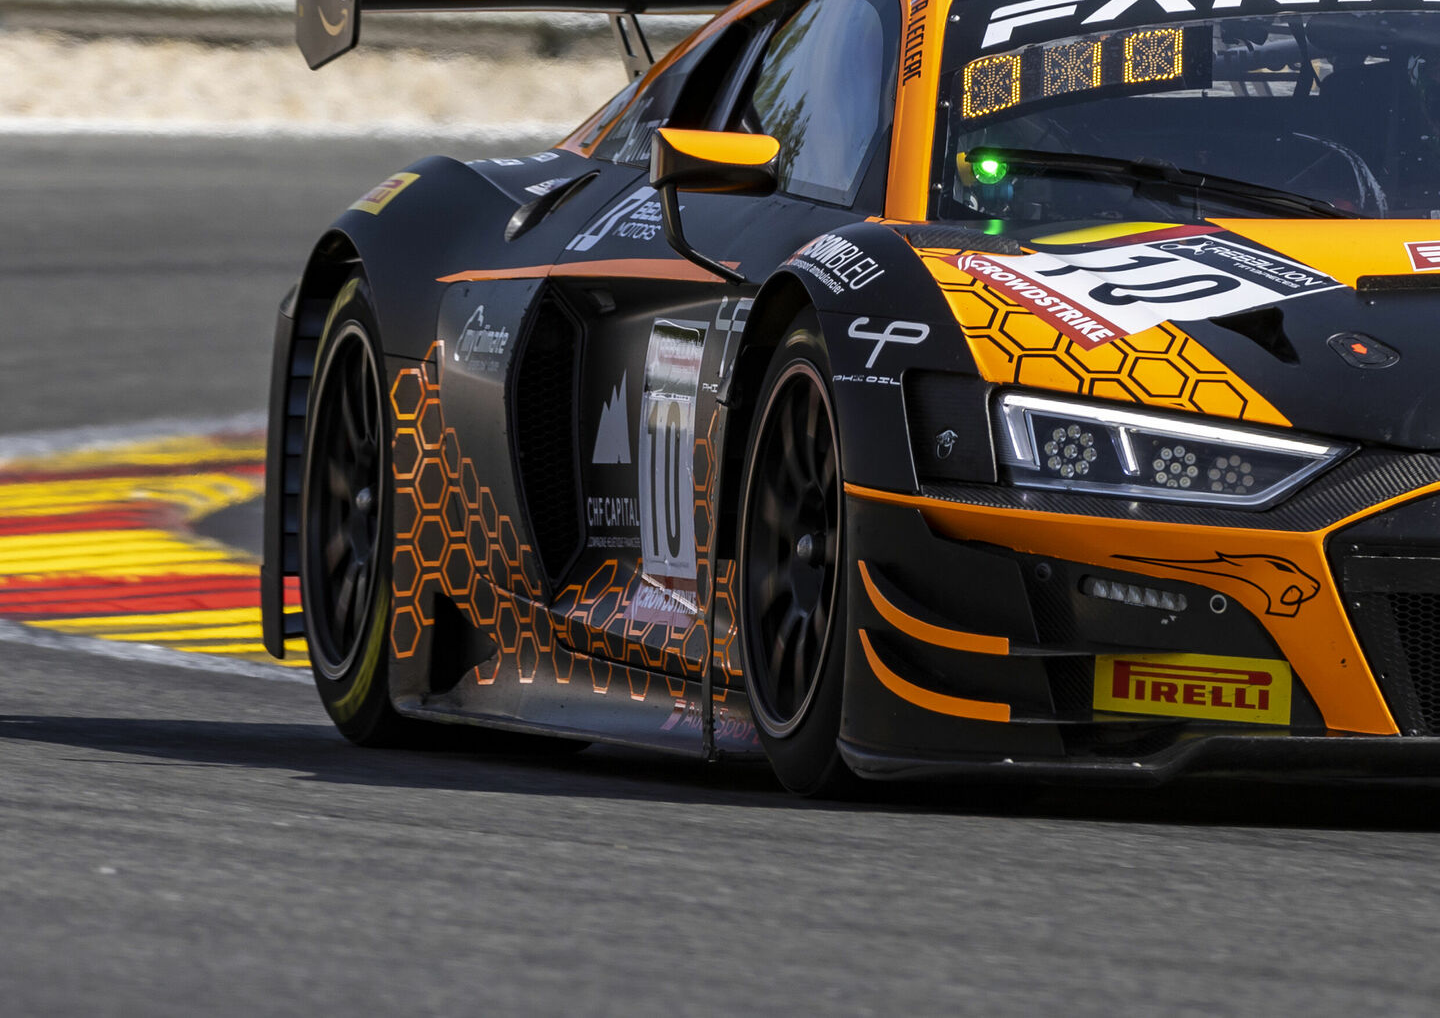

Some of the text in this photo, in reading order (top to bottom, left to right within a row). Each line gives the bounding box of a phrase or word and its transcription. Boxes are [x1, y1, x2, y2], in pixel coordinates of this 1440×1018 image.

[1034, 255, 1242, 306] 10
[1208, 246, 1324, 287] REBELLION
[970, 259, 1116, 343] CROWDSTRIKE
[648, 401, 681, 559] 10
[587, 497, 640, 527] CHF CAPITAL
[1112, 660, 1273, 711] PIRELLI
